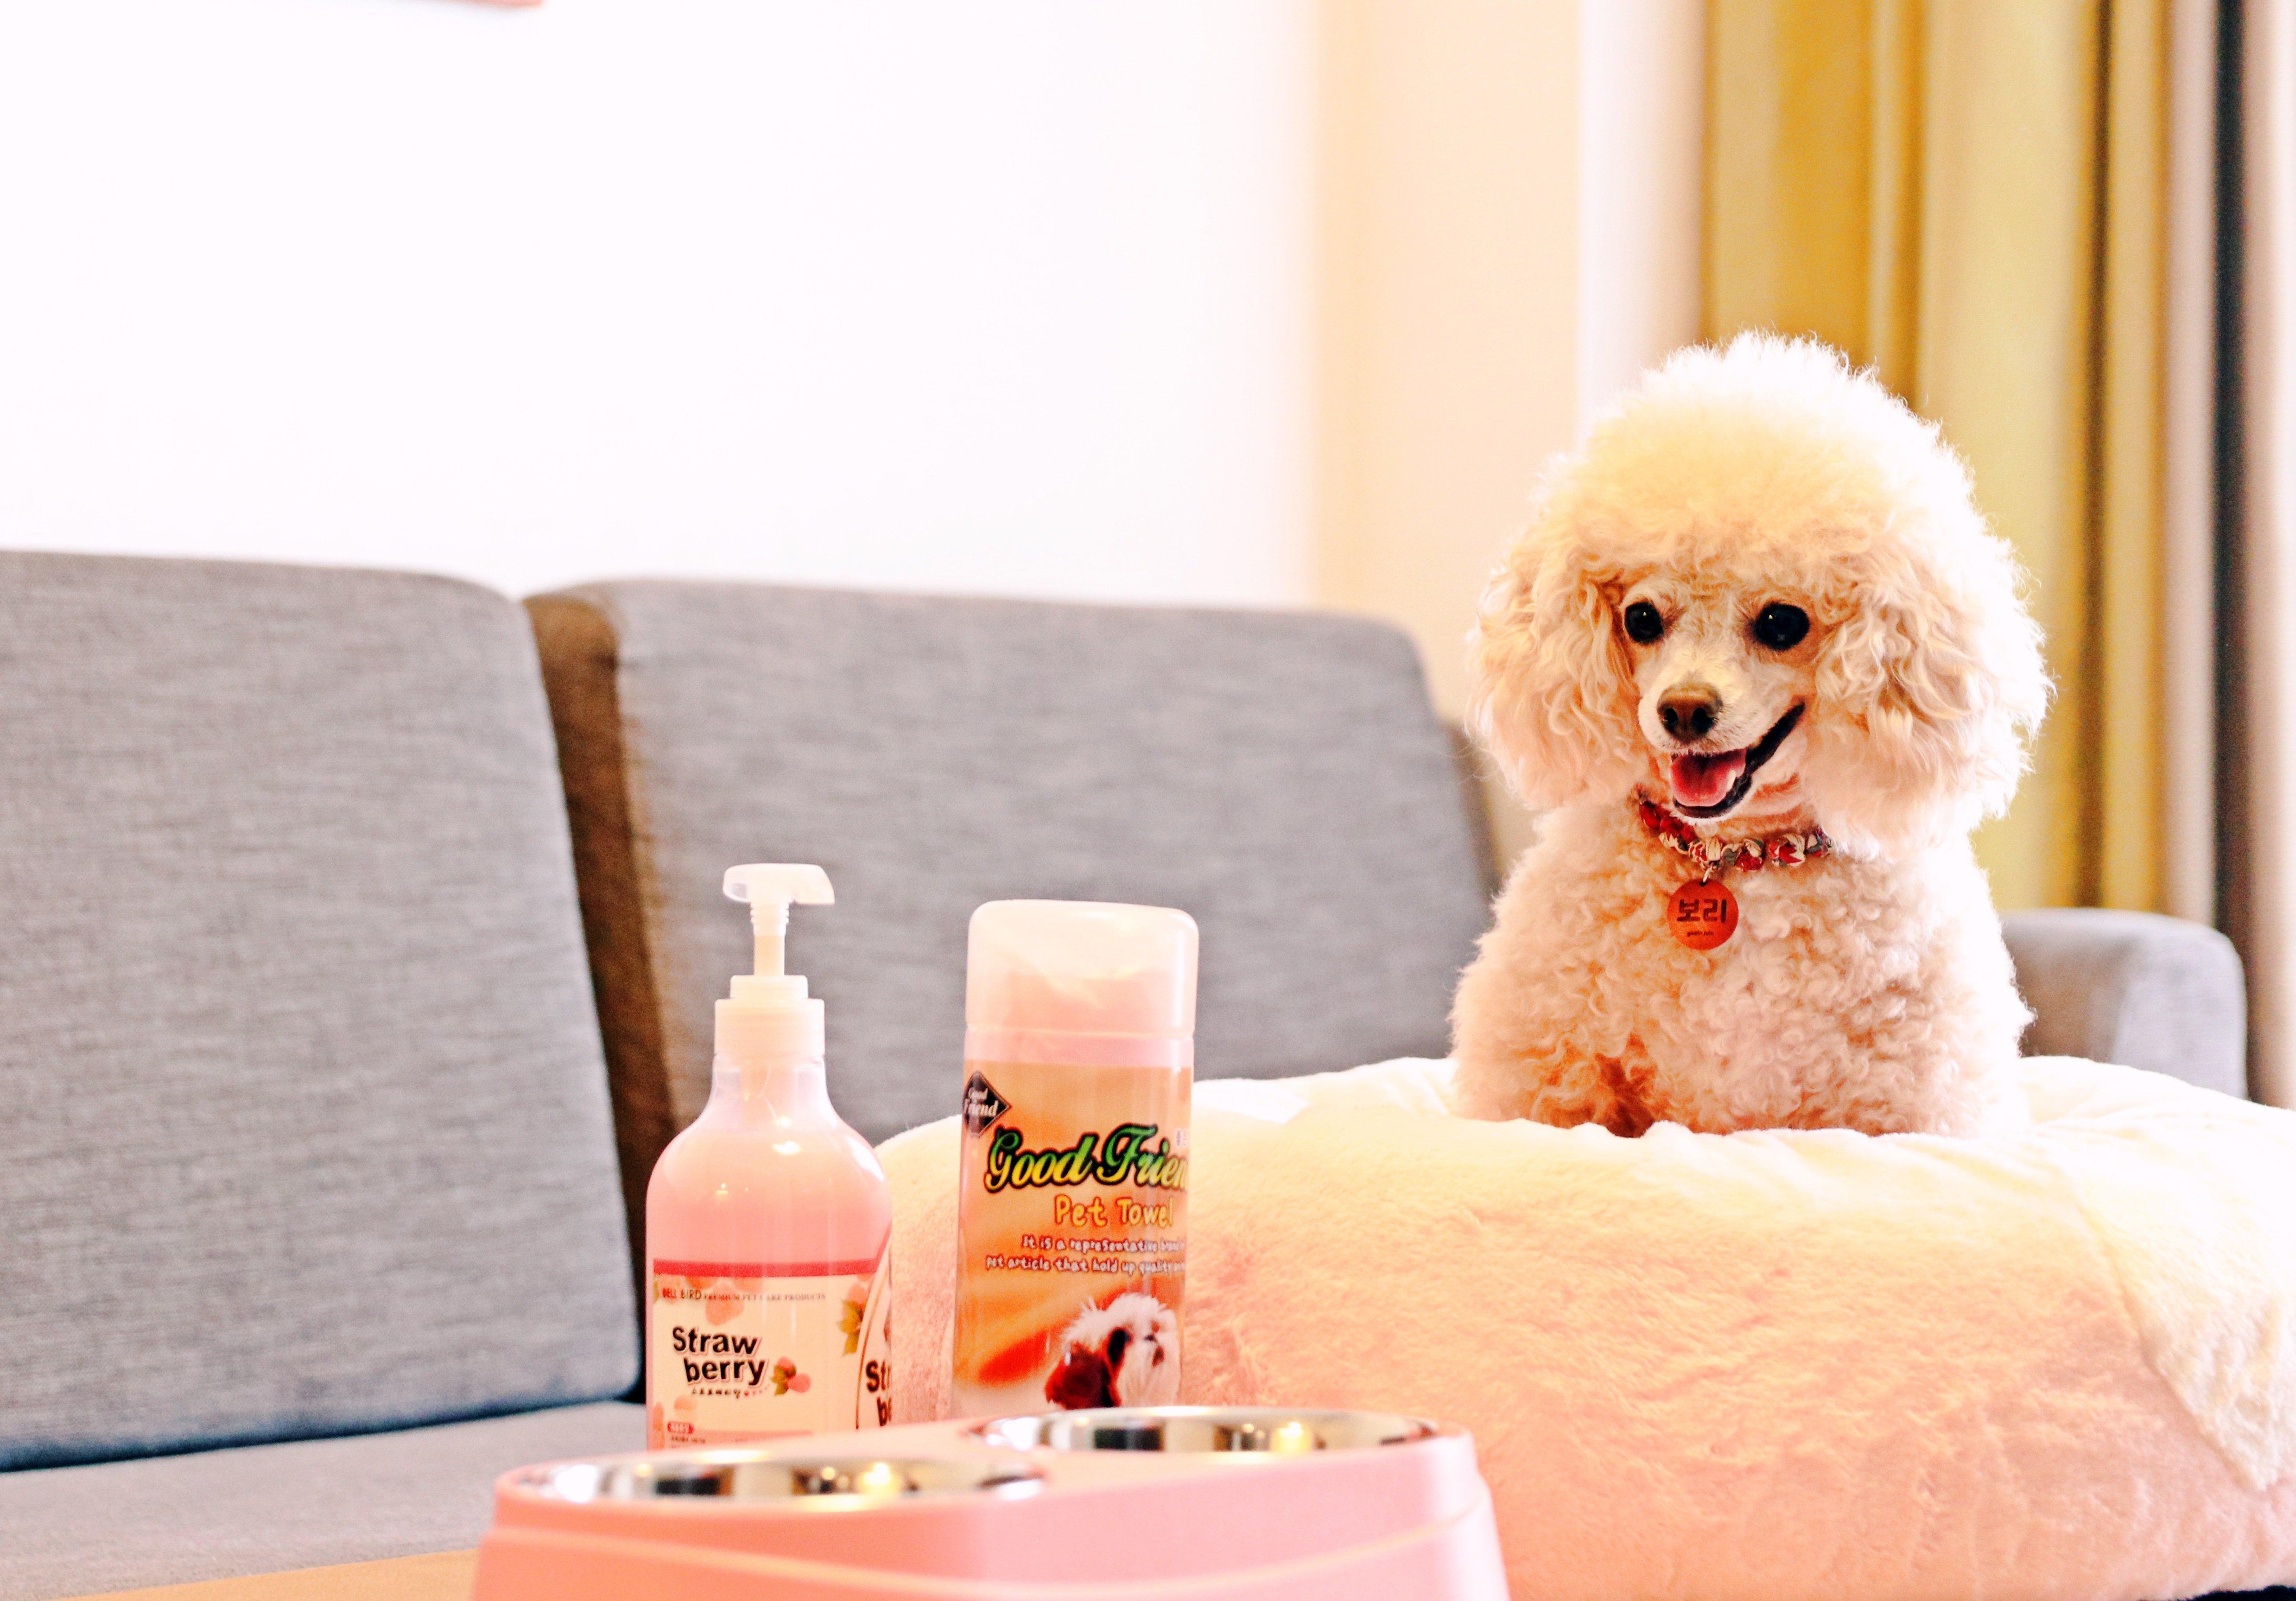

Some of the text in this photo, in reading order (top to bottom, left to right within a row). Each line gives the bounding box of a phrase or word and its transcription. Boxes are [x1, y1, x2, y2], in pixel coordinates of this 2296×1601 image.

[1677, 899, 1727, 924] 보리
[984, 1122, 1187, 1194] Good Frien
[1054, 1194, 1174, 1228] Pet Towel
[1055, 1238, 1067, 1251] a
[985, 1254, 1004, 1271] pet
[1007, 1255, 1051, 1271] article
[1053, 1256, 1089, 1273] that
[1092, 1257, 1119, 1274] hold
[1121, 1261, 1136, 1276] up
[672, 1325, 760, 1355] Straw
[683, 1357, 766, 1386] berry
